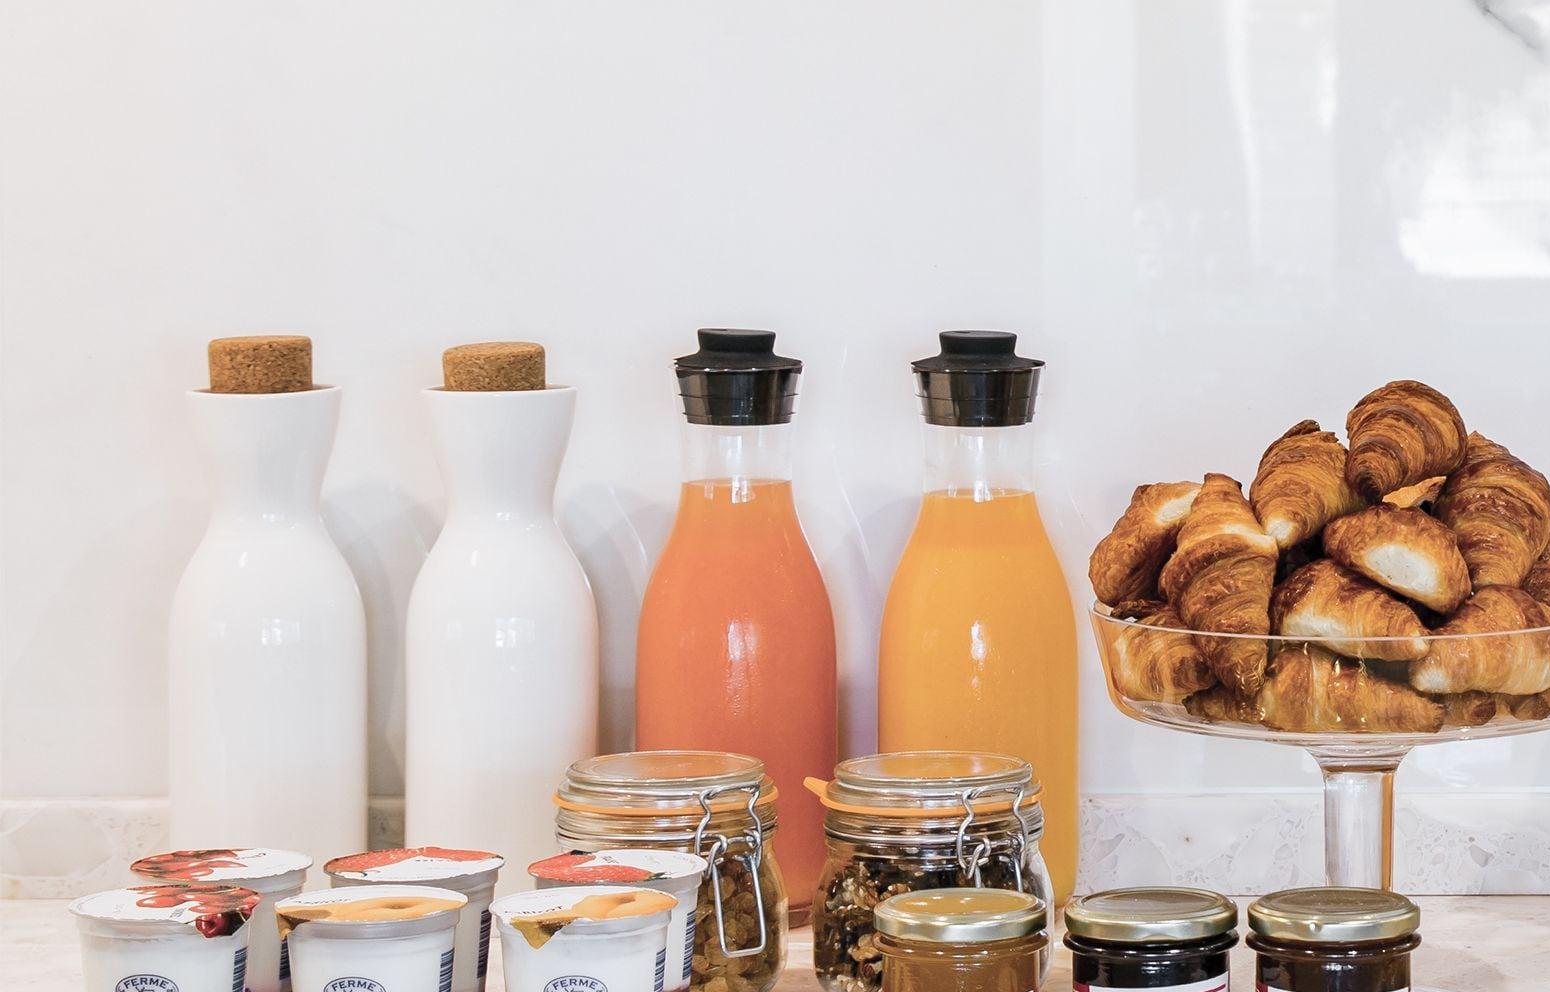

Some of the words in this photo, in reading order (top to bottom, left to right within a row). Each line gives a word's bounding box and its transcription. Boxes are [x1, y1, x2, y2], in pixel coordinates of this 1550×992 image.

[124, 977, 169, 989] FERME
[332, 980, 376, 992] FERME
[552, 978, 598, 990] FERME
